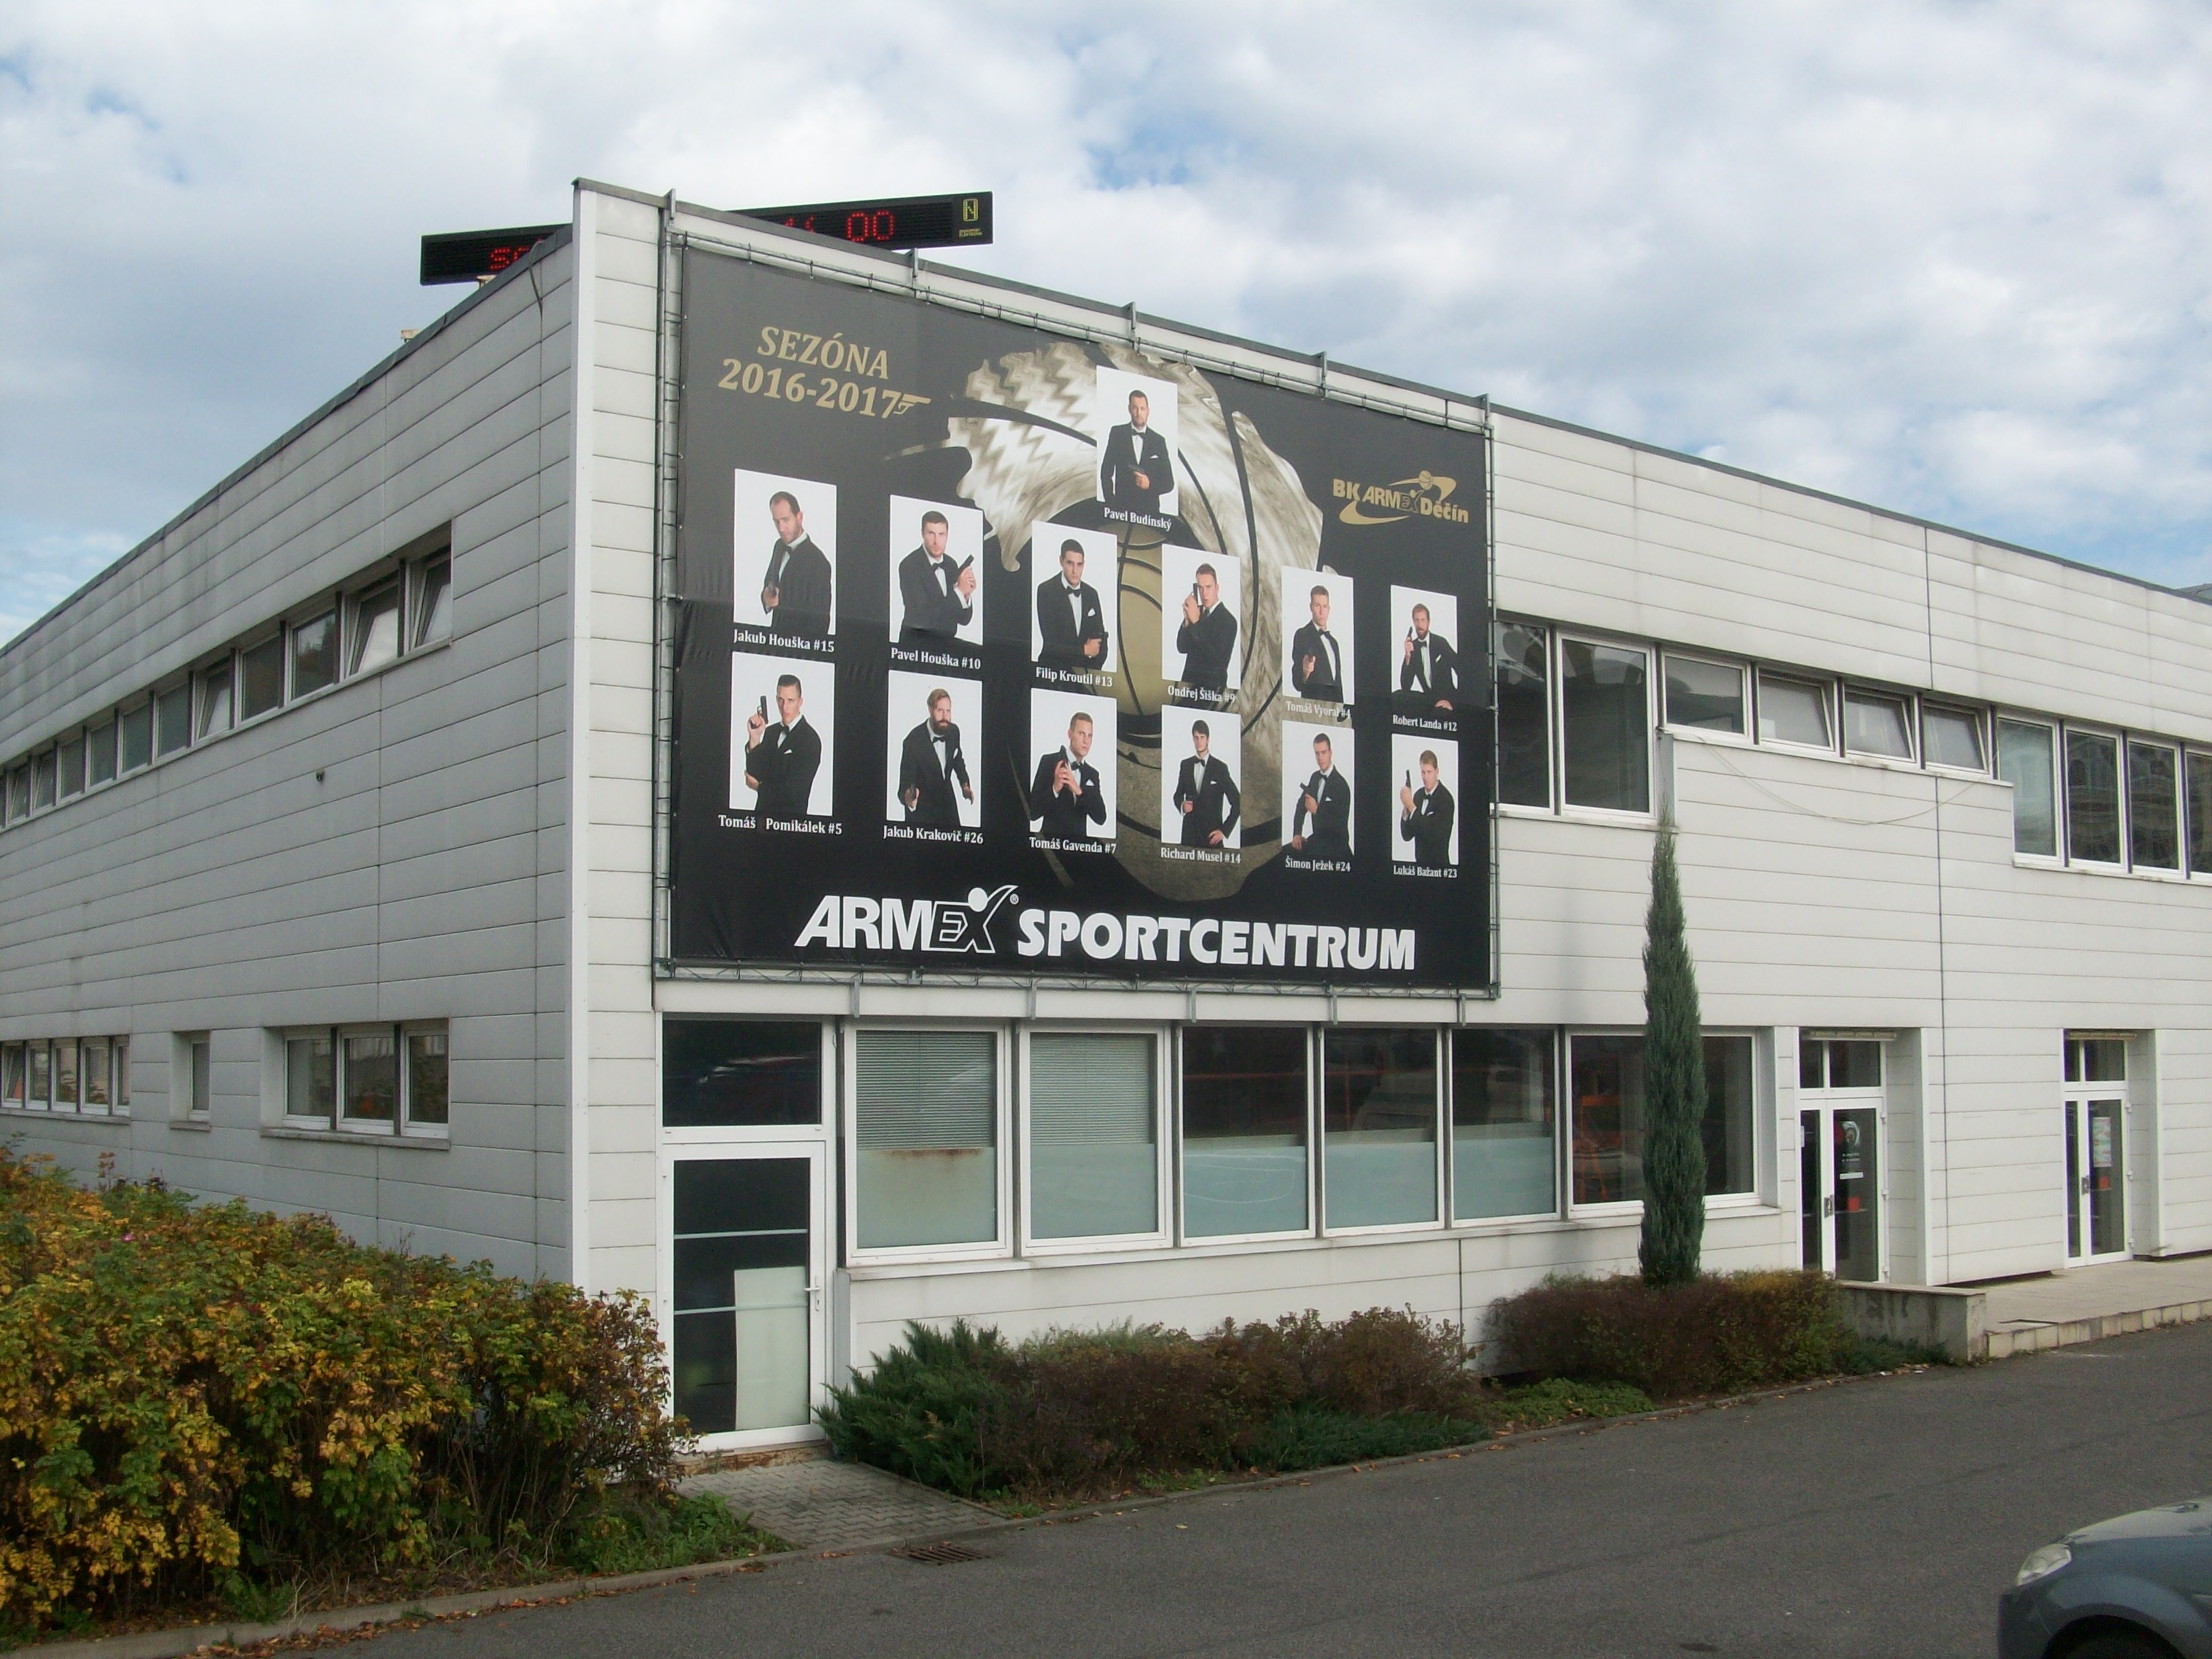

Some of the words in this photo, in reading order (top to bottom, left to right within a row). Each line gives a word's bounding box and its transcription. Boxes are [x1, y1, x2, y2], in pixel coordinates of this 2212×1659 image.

[757, 326, 889, 380] SEZÓNA
[718, 358, 904, 419] 2016-2017
[1333, 477, 1361, 501] BK
[1420, 496, 1469, 523] Děčín
[1104, 506, 1128, 522] Pavel
[733, 629, 766, 643] Jakub
[769, 633, 811, 650] Houška
[813, 639, 835, 653] #15
[891, 647, 918, 662] Pavel
[921, 651, 959, 667] Houška
[961, 657, 981, 670] #10
[1036, 666, 1057, 682] Filip
[1059, 670, 1093, 685] Kroutil
[1095, 675, 1113, 687] #13
[1167, 685, 1198, 701] Ondřej
[1393, 714, 1418, 727] Robert
[1420, 718, 1442, 730] Landa
[1443, 721, 1457, 732] #12
[718, 814, 756, 829] Tomáš
[765, 817, 826, 834] Pomikálek
[827, 822, 843, 835] #5
[883, 825, 914, 840] Jakub
[916, 827, 962, 842] Krakovič
[964, 832, 984, 844] #26
[1029, 836, 1061, 850] Tomáš
[1063, 839, 1103, 853] Gavenda
[1105, 842, 1117, 854] #7
[1161, 847, 1195, 861] Richard
[1197, 850, 1223, 863] Musel
[1224, 853, 1241, 864] #14
[1285, 855, 1311, 869] Šimon
[1312, 859, 1334, 872] Ježek
[1017, 908, 1416, 970] SPORTCENTRUM
